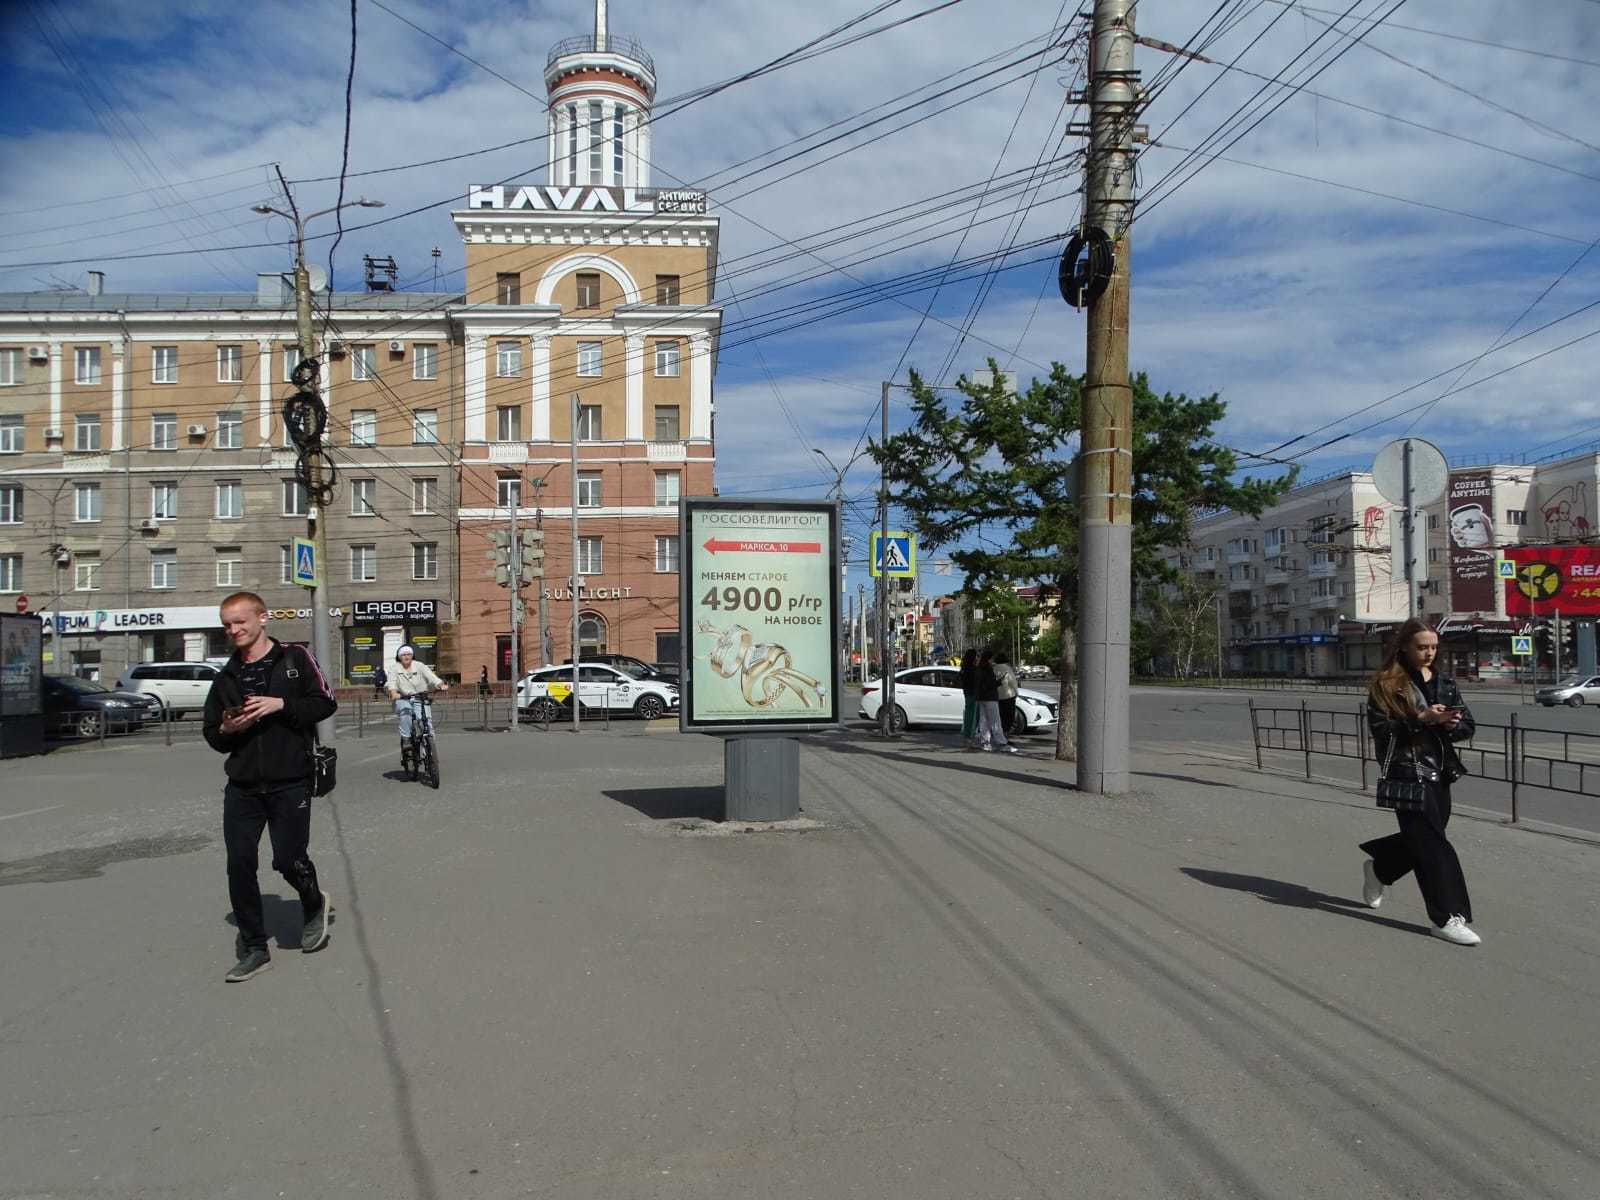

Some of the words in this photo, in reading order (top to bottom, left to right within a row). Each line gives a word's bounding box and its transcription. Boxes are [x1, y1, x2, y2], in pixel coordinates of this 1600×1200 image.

[469, 184, 655, 212] HAVAL
[658, 191, 705, 202] АНТИКОР
[658, 202, 705, 213] СЕРВИС
[1454, 480, 1487, 490] COFFEE
[1450, 488, 1491, 498] ANYTIME
[701, 513, 822, 526] РОССЮВЕЛИРТОРГ
[740, 543, 778, 552] МАРКСА,
[779, 543, 788, 551] 10
[701, 571, 746, 581] МЕНЯЕМ
[748, 572, 789, 582] СТАРОЕ
[701, 586, 782, 611] 4900
[788, 594, 822, 611] р/гр
[354, 601, 434, 614] LABORA
[115, 613, 165, 626] LEADER
[764, 616, 782, 625] НА
[783, 615, 823, 625] НОВОЕ
